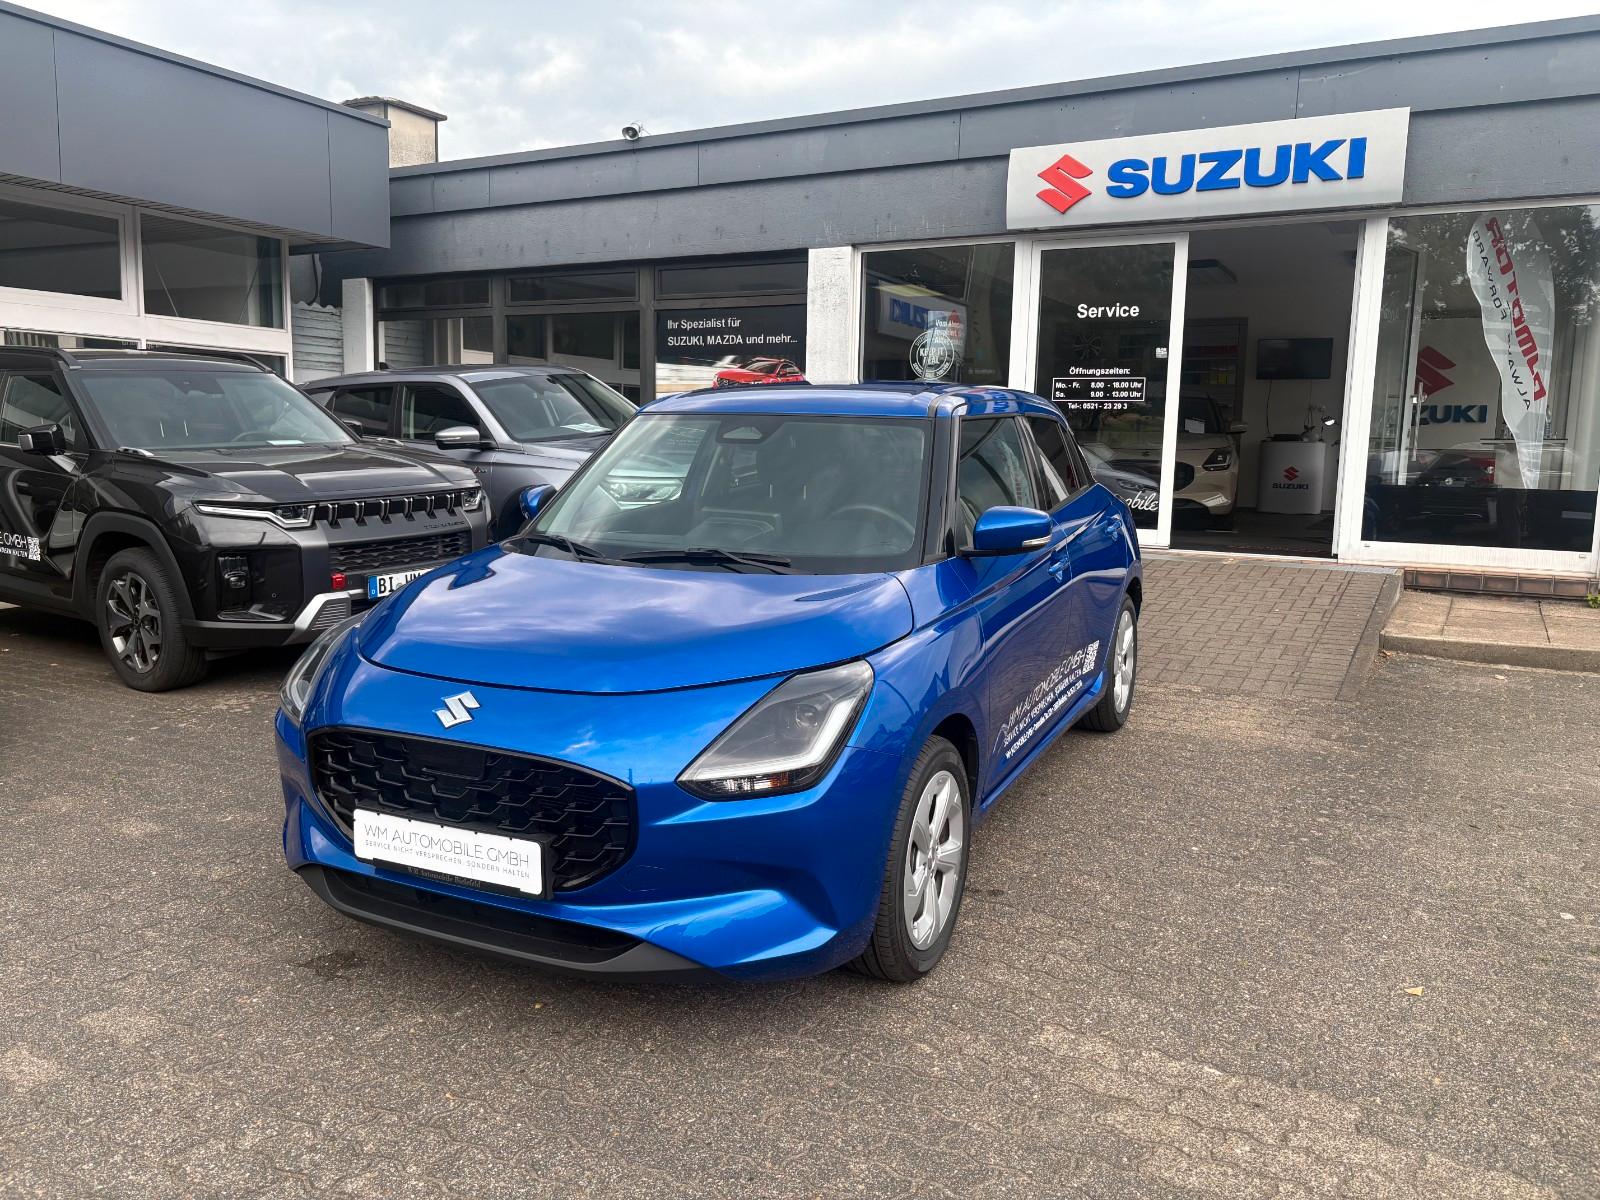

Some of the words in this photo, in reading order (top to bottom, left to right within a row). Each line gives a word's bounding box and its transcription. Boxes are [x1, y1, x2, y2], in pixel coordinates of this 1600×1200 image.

[1105, 136, 1368, 199] SUZUKI
[1076, 302, 1140, 319] Service
[667, 319, 679, 330] Ihr
[680, 318, 726, 331] Spezialist
[727, 317, 742, 327] für
[667, 335, 705, 347] SUZUKI,
[706, 334, 743, 345] MAZDA
[745, 333, 764, 345] und
[766, 333, 798, 344] mehr...
[1069, 366, 1131, 376] Öffnungszeiten:
[1272, 482, 1309, 490] SUZUKI
[378, 576, 394, 594] BI
[364, 823, 388, 841] WM
[392, 829, 484, 860] AUTOMOBILE
[486, 847, 529, 869] GMBH
[365, 839, 391, 851] SERVICE
[393, 845, 413, 855] NICHT
[466, 859, 500, 873] SONDERN
[502, 867, 530, 879] HALTEN
